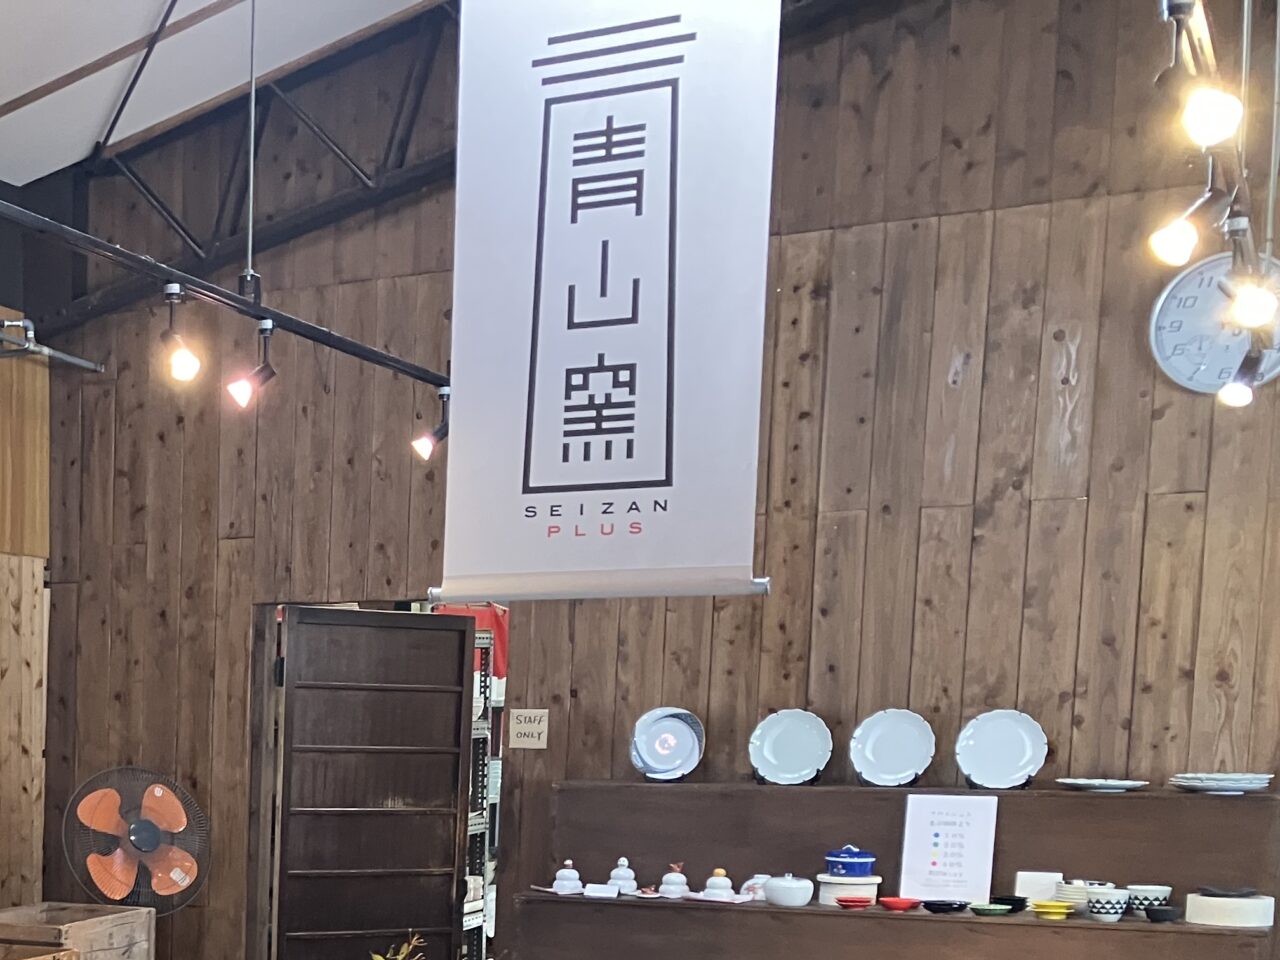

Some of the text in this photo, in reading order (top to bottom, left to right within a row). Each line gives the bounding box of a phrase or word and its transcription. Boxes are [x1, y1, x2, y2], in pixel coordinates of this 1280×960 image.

[1198, 276, 1214, 288] 11
[1176, 296, 1198, 309] 10
[1168, 320, 1183, 333] 9
[1218, 367, 1234, 380] 6
[524, 499, 668, 518] SEIZAN
[547, 522, 642, 538] PLUS
[515, 714, 545, 725] STAFF
[516, 731, 544, 741] ONLY
